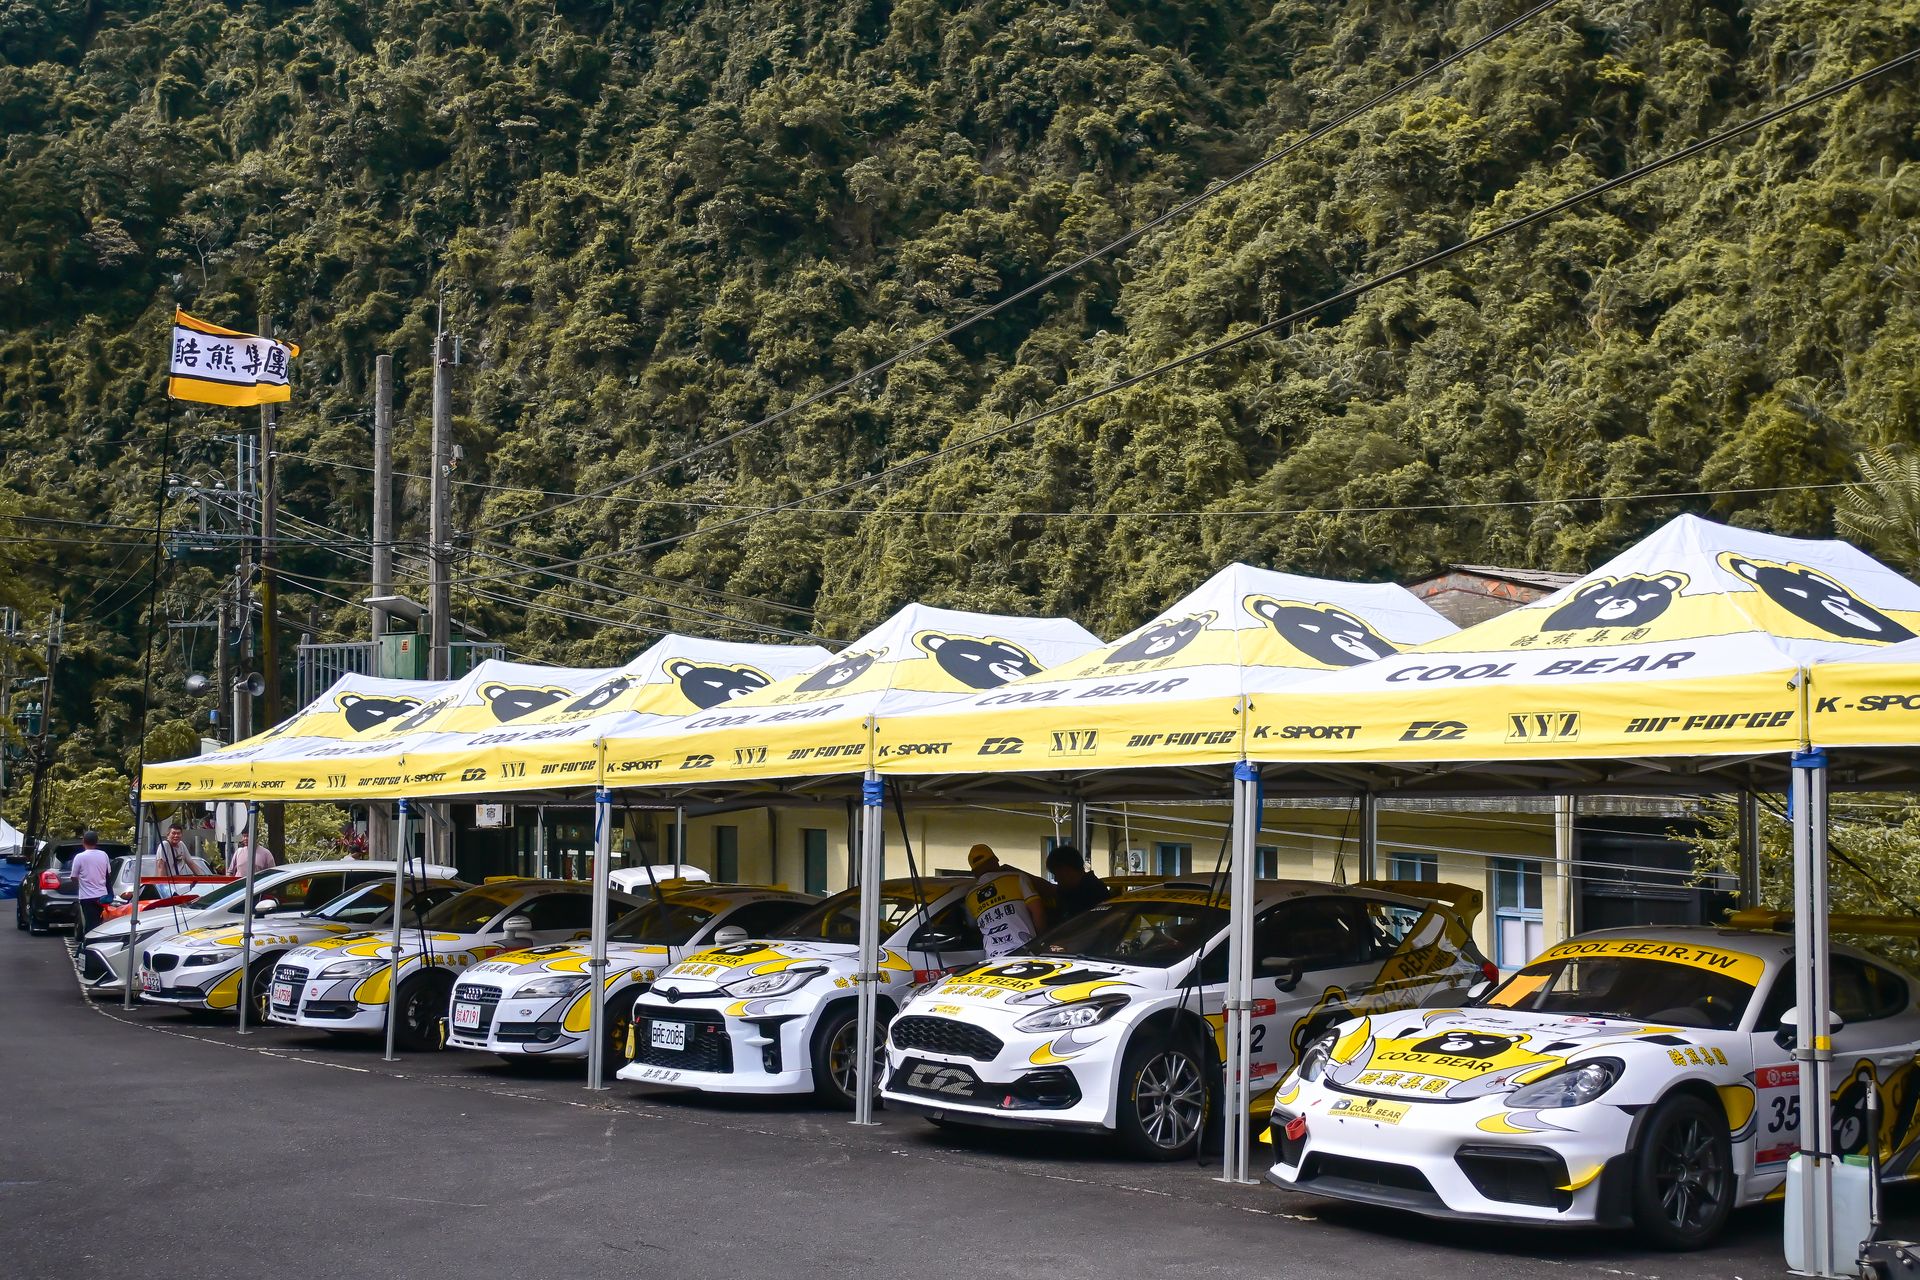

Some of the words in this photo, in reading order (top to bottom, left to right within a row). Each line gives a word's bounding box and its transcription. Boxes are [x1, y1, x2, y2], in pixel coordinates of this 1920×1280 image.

[176, 338, 288, 379] 酷熊集團
[1385, 662, 1517, 683] COOL
[1534, 651, 1696, 676] BEAR
[974, 689, 1070, 706] COOL
[1073, 677, 1189, 699] BEAR
[684, 714, 752, 729] COOL
[758, 703, 844, 723] BEAR
[1252, 725, 1362, 739] K-SPORT
[1398, 721, 1469, 742] D2
[1509, 713, 1579, 738] XYZ
[878, 742, 953, 757] K-SPORT
[977, 737, 1024, 755] D2
[1051, 729, 1097, 753] XYZ
[679, 754, 716, 770] D2
[734, 746, 767, 765] XYZ
[460, 768, 487, 782] D2
[501, 762, 526, 778] XYZ
[606, 759, 662, 773] K-SPORT
[403, 772, 447, 783] K-SPORT
[1549, 942, 1738, 969] COOL-BEAR.TW
[989, 977, 1034, 990] BEAR
[1377, 1051, 1428, 1063] COOL
[1434, 1056, 1494, 1073] BEAR
[1349, 1104, 1374, 1114] COOL
[1374, 1108, 1402, 1120] BEAR
